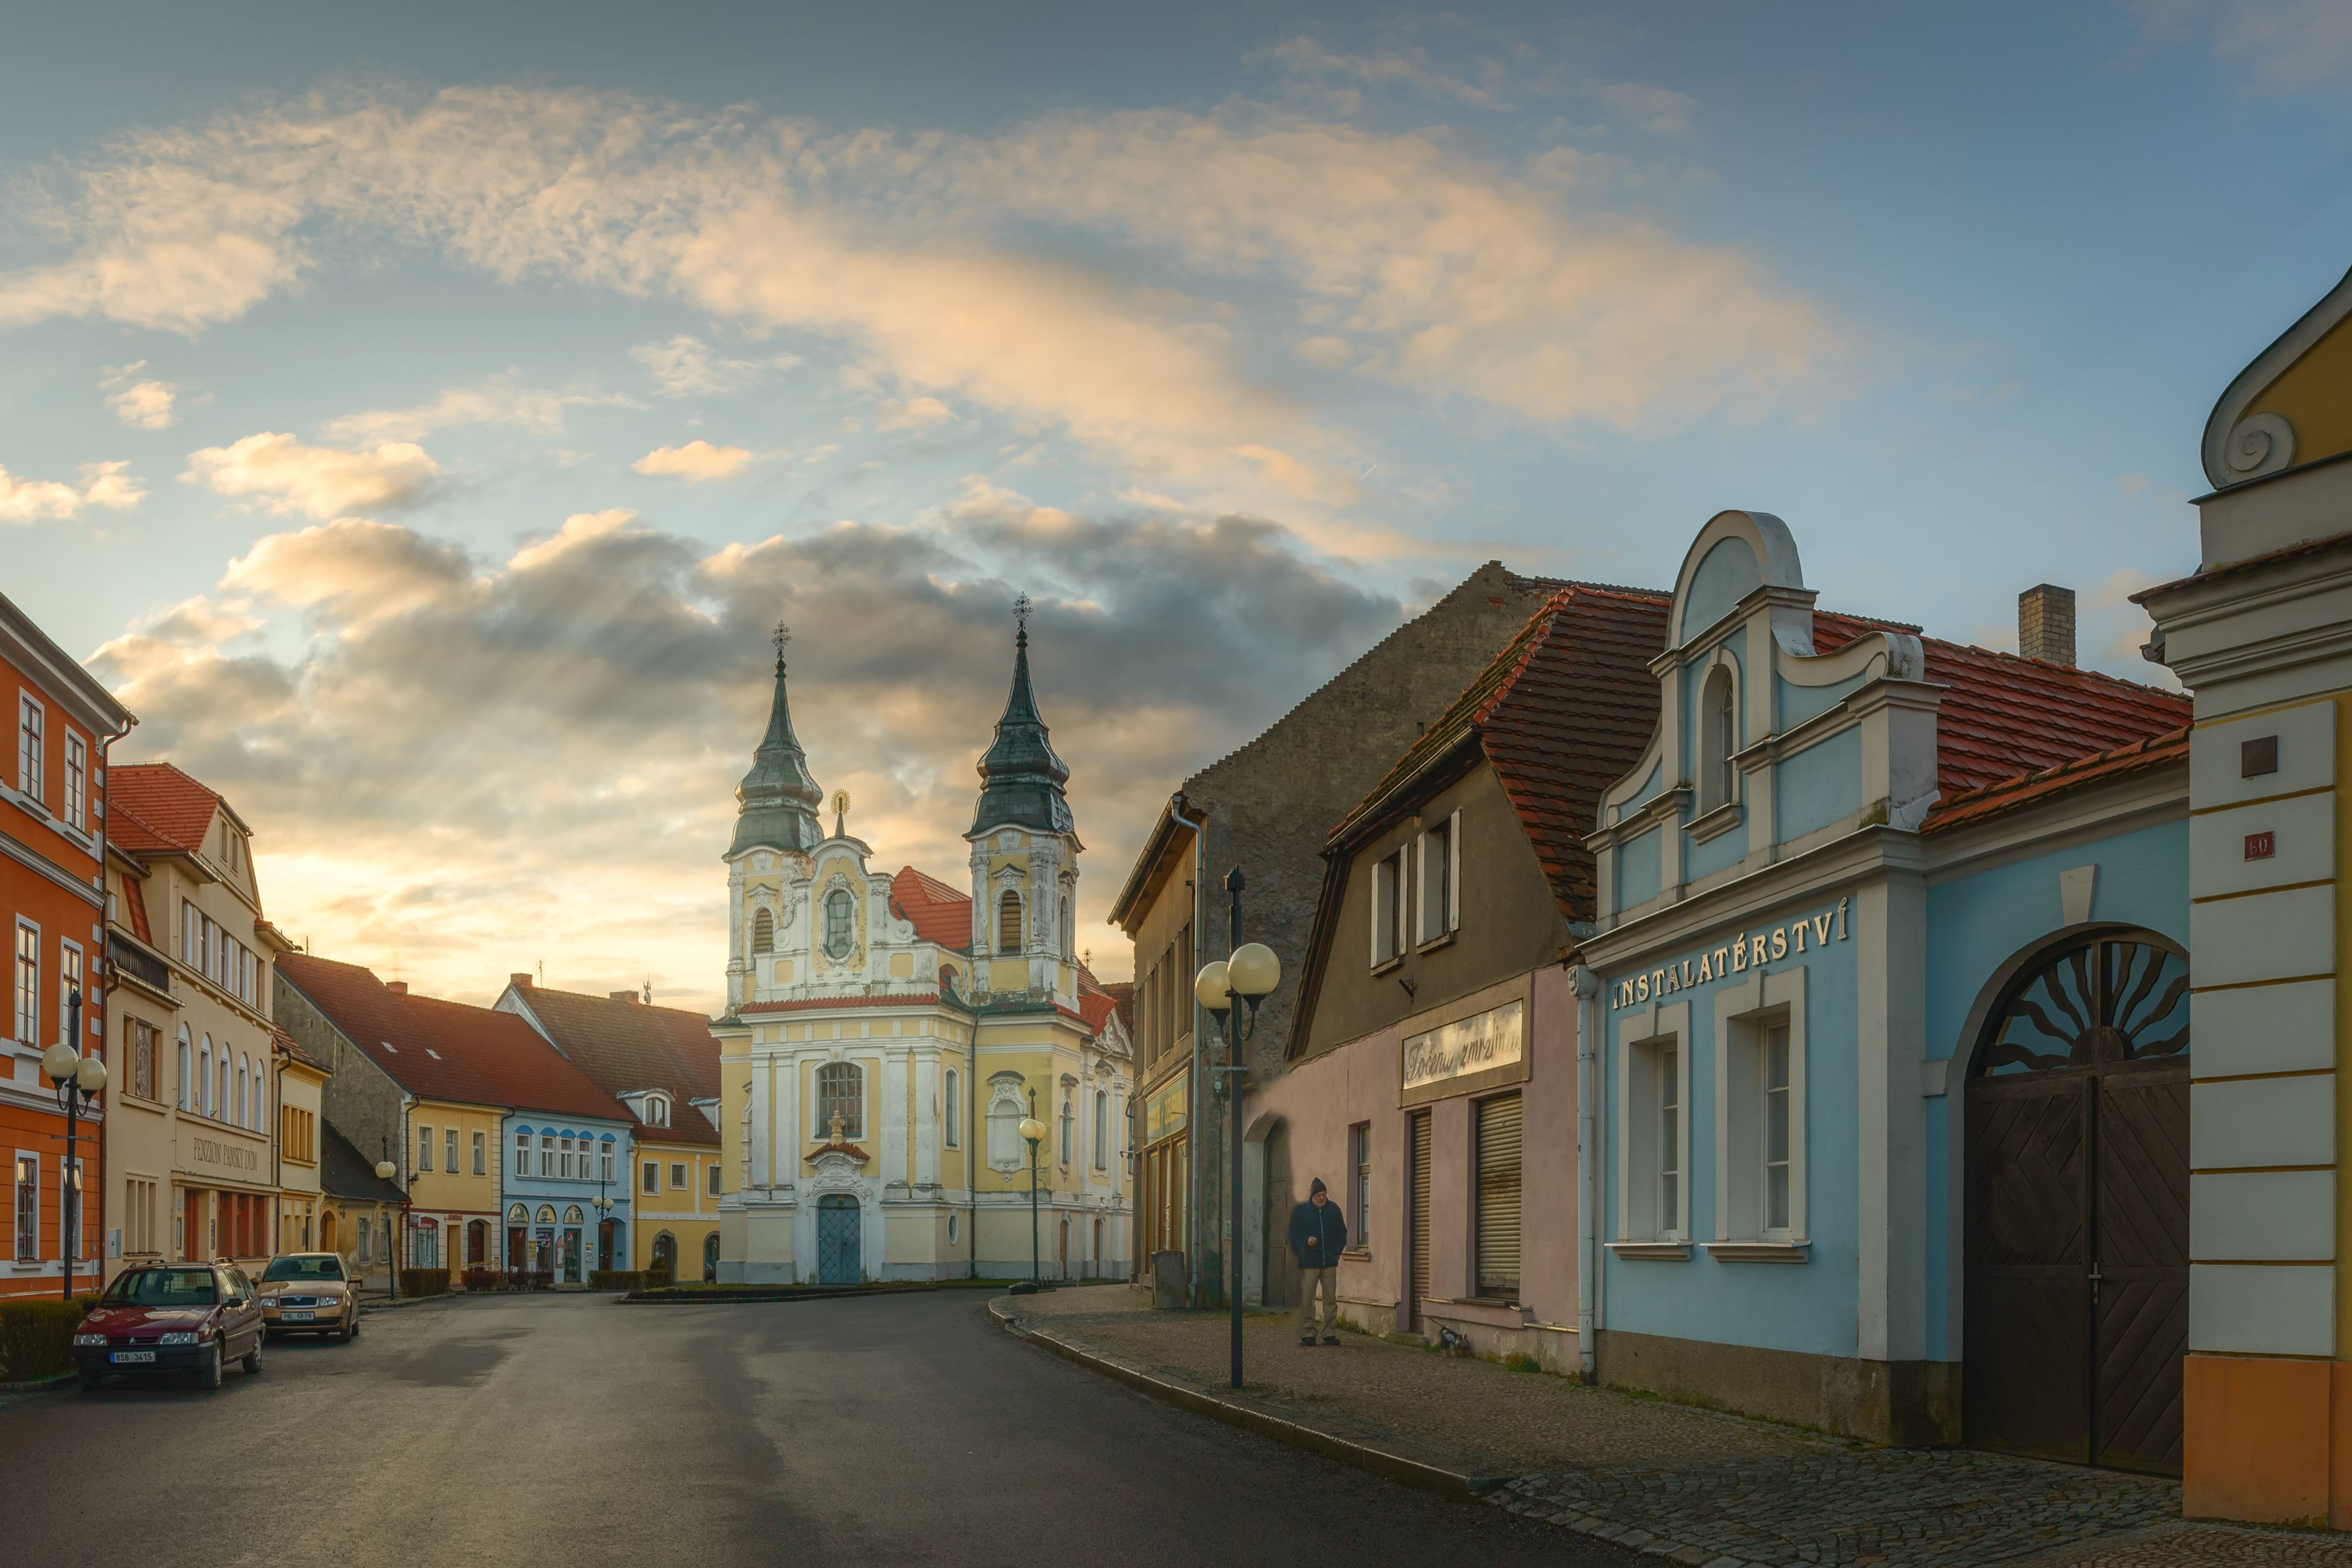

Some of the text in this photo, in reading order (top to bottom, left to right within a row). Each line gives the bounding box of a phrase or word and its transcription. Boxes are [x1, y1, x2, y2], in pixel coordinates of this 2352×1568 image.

[2249, 837, 2268, 855] 60
[1612, 897, 1849, 1010] INSTALATÉRSTVÍ
[193, 1137, 258, 1171] PENZION PANSKÝ DŮM
[134, 1352, 153, 1361] 3415
